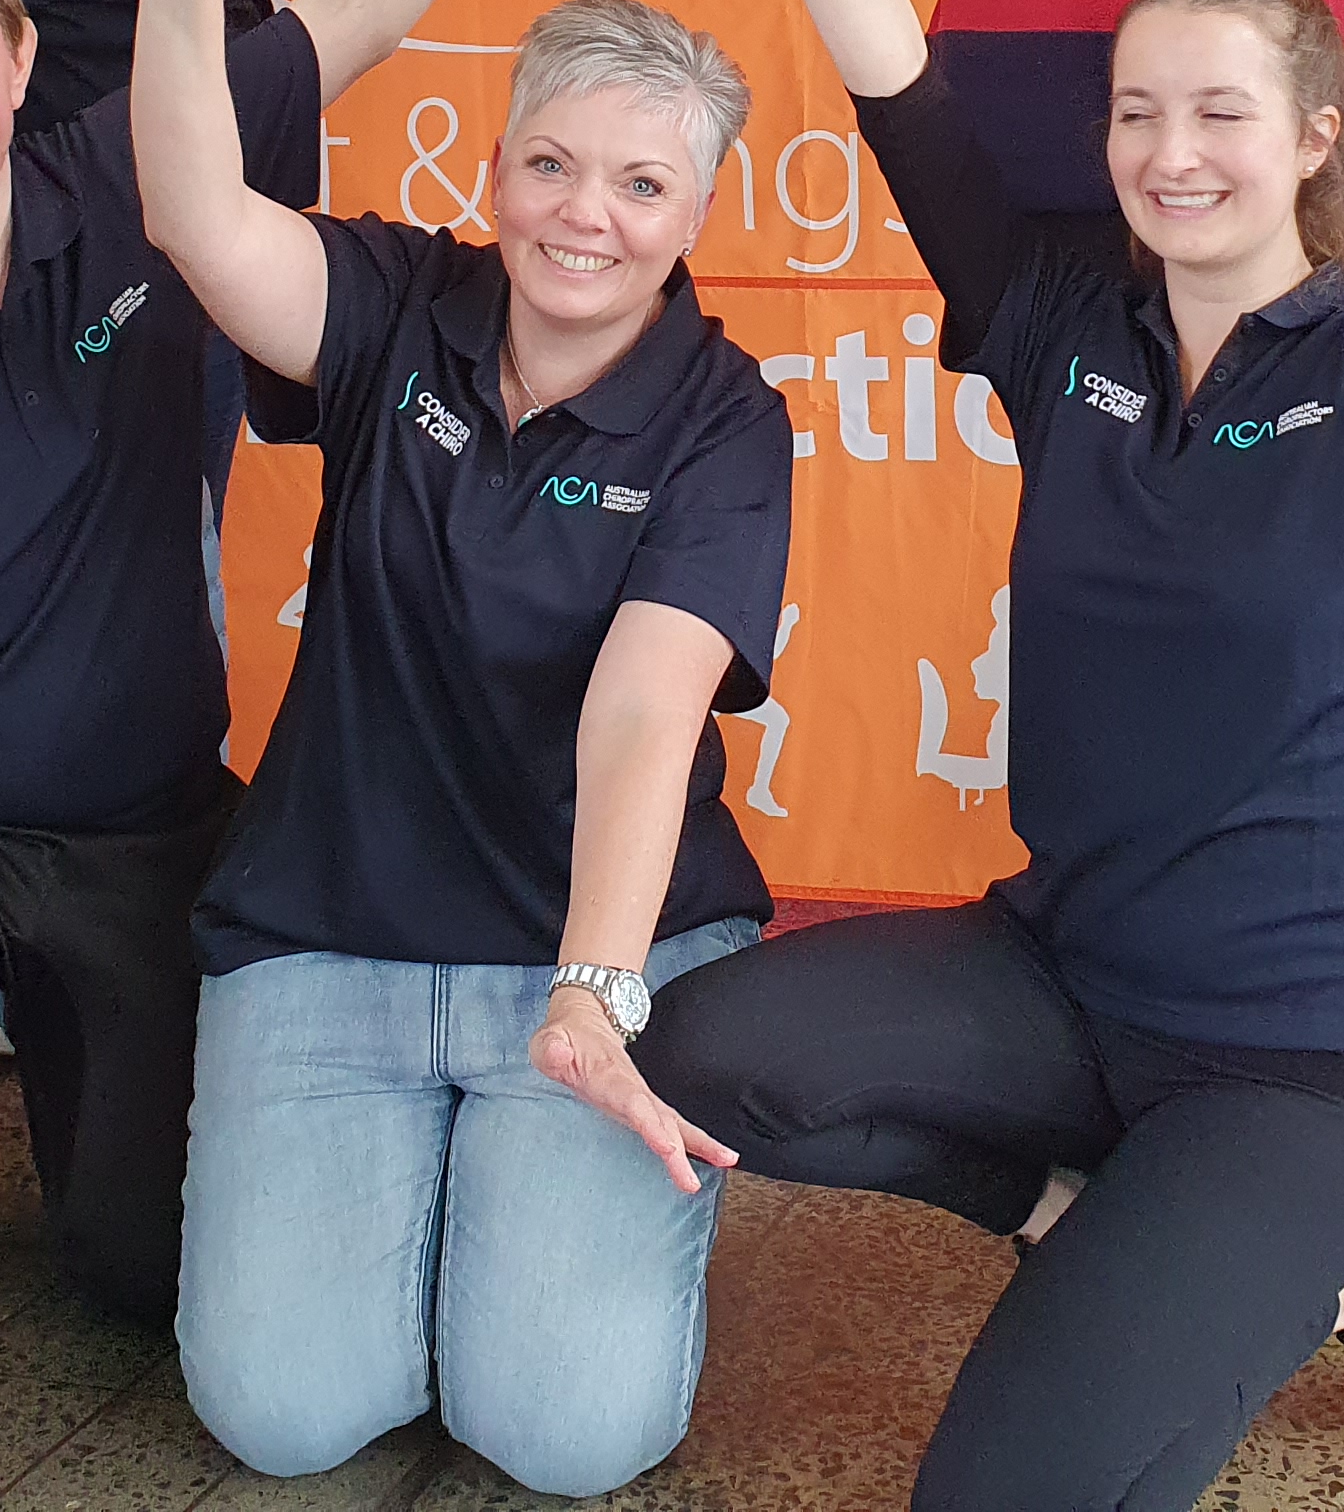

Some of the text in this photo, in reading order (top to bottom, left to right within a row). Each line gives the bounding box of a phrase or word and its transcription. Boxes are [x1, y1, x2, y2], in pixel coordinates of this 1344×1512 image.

[400, 96, 492, 236] &
[417, 391, 471, 445] CONSIDER
[1084, 391, 1141, 424] A CHIRO
[415, 413, 463, 457] A CHIRO
